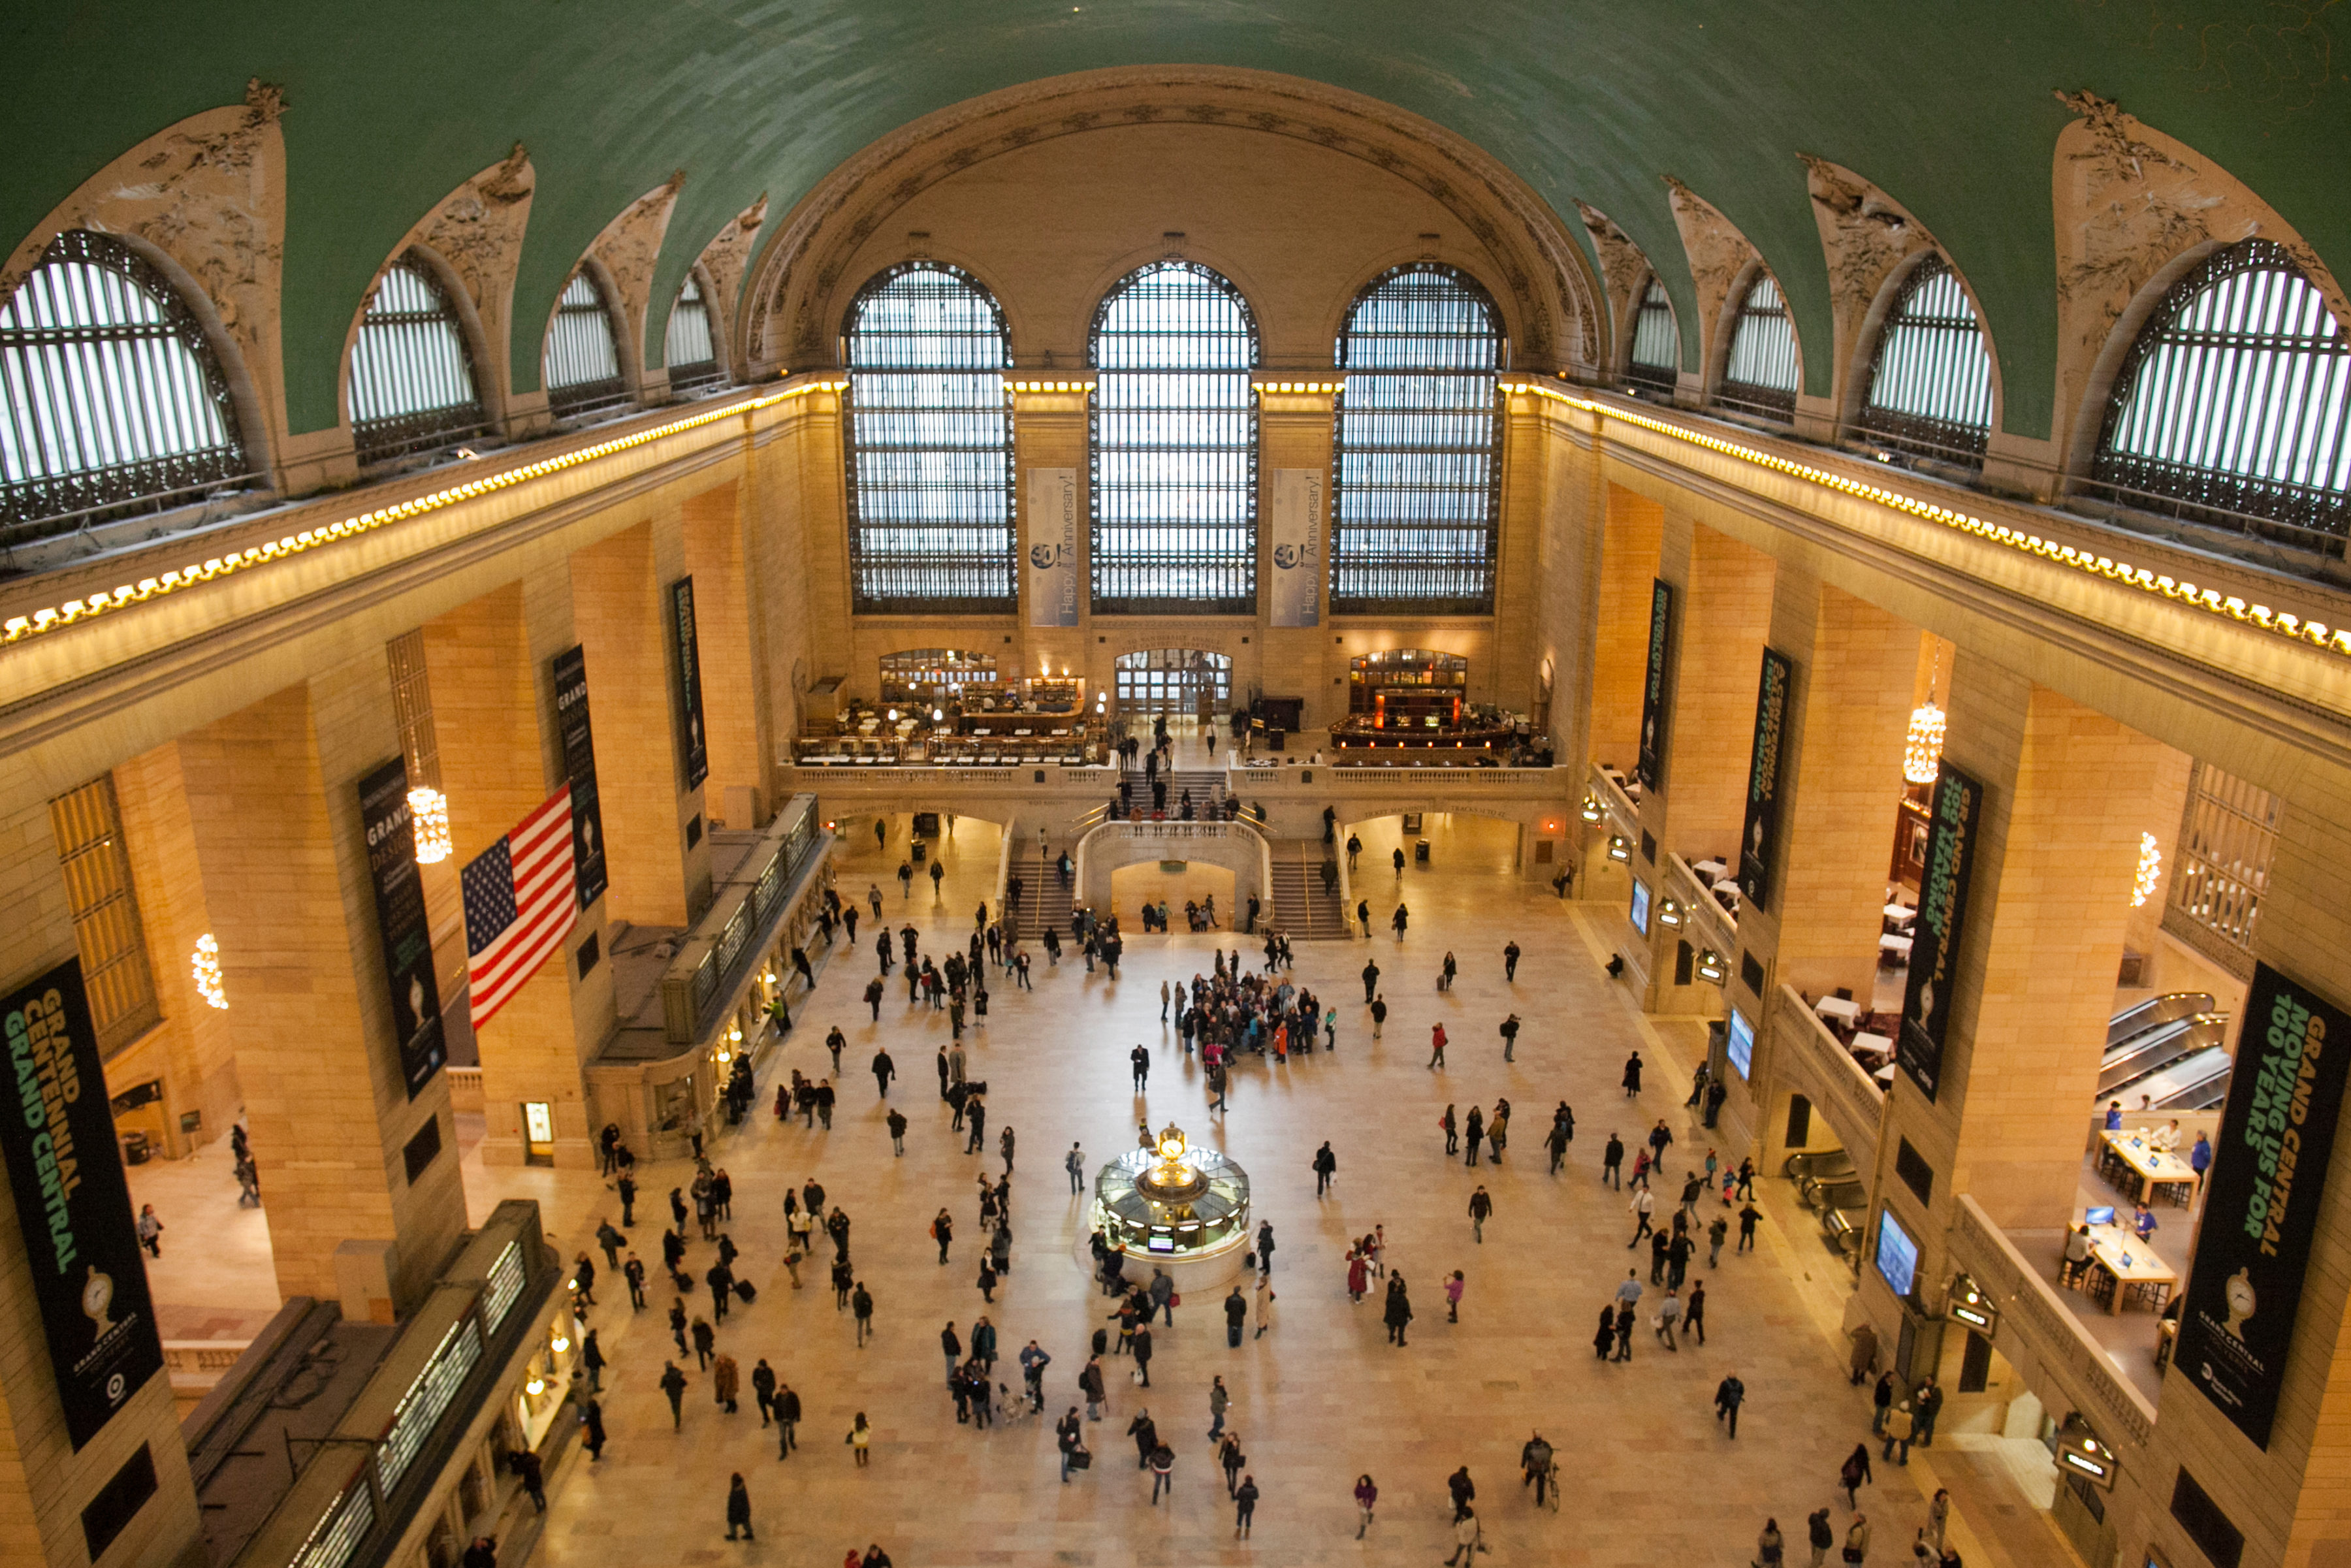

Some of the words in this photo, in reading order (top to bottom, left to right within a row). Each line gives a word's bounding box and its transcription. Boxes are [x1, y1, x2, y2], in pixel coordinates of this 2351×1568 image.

[1059, 475, 1075, 556] Anniversary!
[1305, 476, 1322, 556] Anniversary!
[1061, 570, 1075, 614] Happy
[1303, 570, 1319, 615] Happy
[558, 681, 586, 711] GRAND
[1753, 732, 1766, 803] GRAND
[1940, 775, 1955, 820] THE
[367, 802, 411, 847] GRAND
[940, 806, 965, 814] STREET
[1365, 809, 1388, 818] TICKET
[1949, 781, 1962, 825] 100
[1951, 788, 1971, 876] GRAND
[1926, 824, 1948, 923] MAKING
[1936, 829, 1957, 906] YEARS
[1932, 908, 1943, 938] IN
[1934, 878, 1957, 981] CENTRAL
[42, 987, 80, 1104] GRAND
[2266, 993, 2292, 1049] 100
[24, 999, 82, 1200] CENTENNIAL
[2267, 1002, 2310, 1133] MOVING
[2290, 1015, 2326, 1125] GRAND
[2244, 1053, 2282, 1152] YEARS
[5, 1009, 45, 1130] GRAND
[31, 1131, 77, 1275] CENTRAL
[2258, 1134, 2281, 1177] US
[2244, 1177, 2272, 1240] FOR
[2260, 1127, 2301, 1257] CENTRAL
[73, 1343, 103, 1373] GRAND
[2199, 1310, 2226, 1337] GRAND
[2226, 1336, 2265, 1372] CENTRAL
